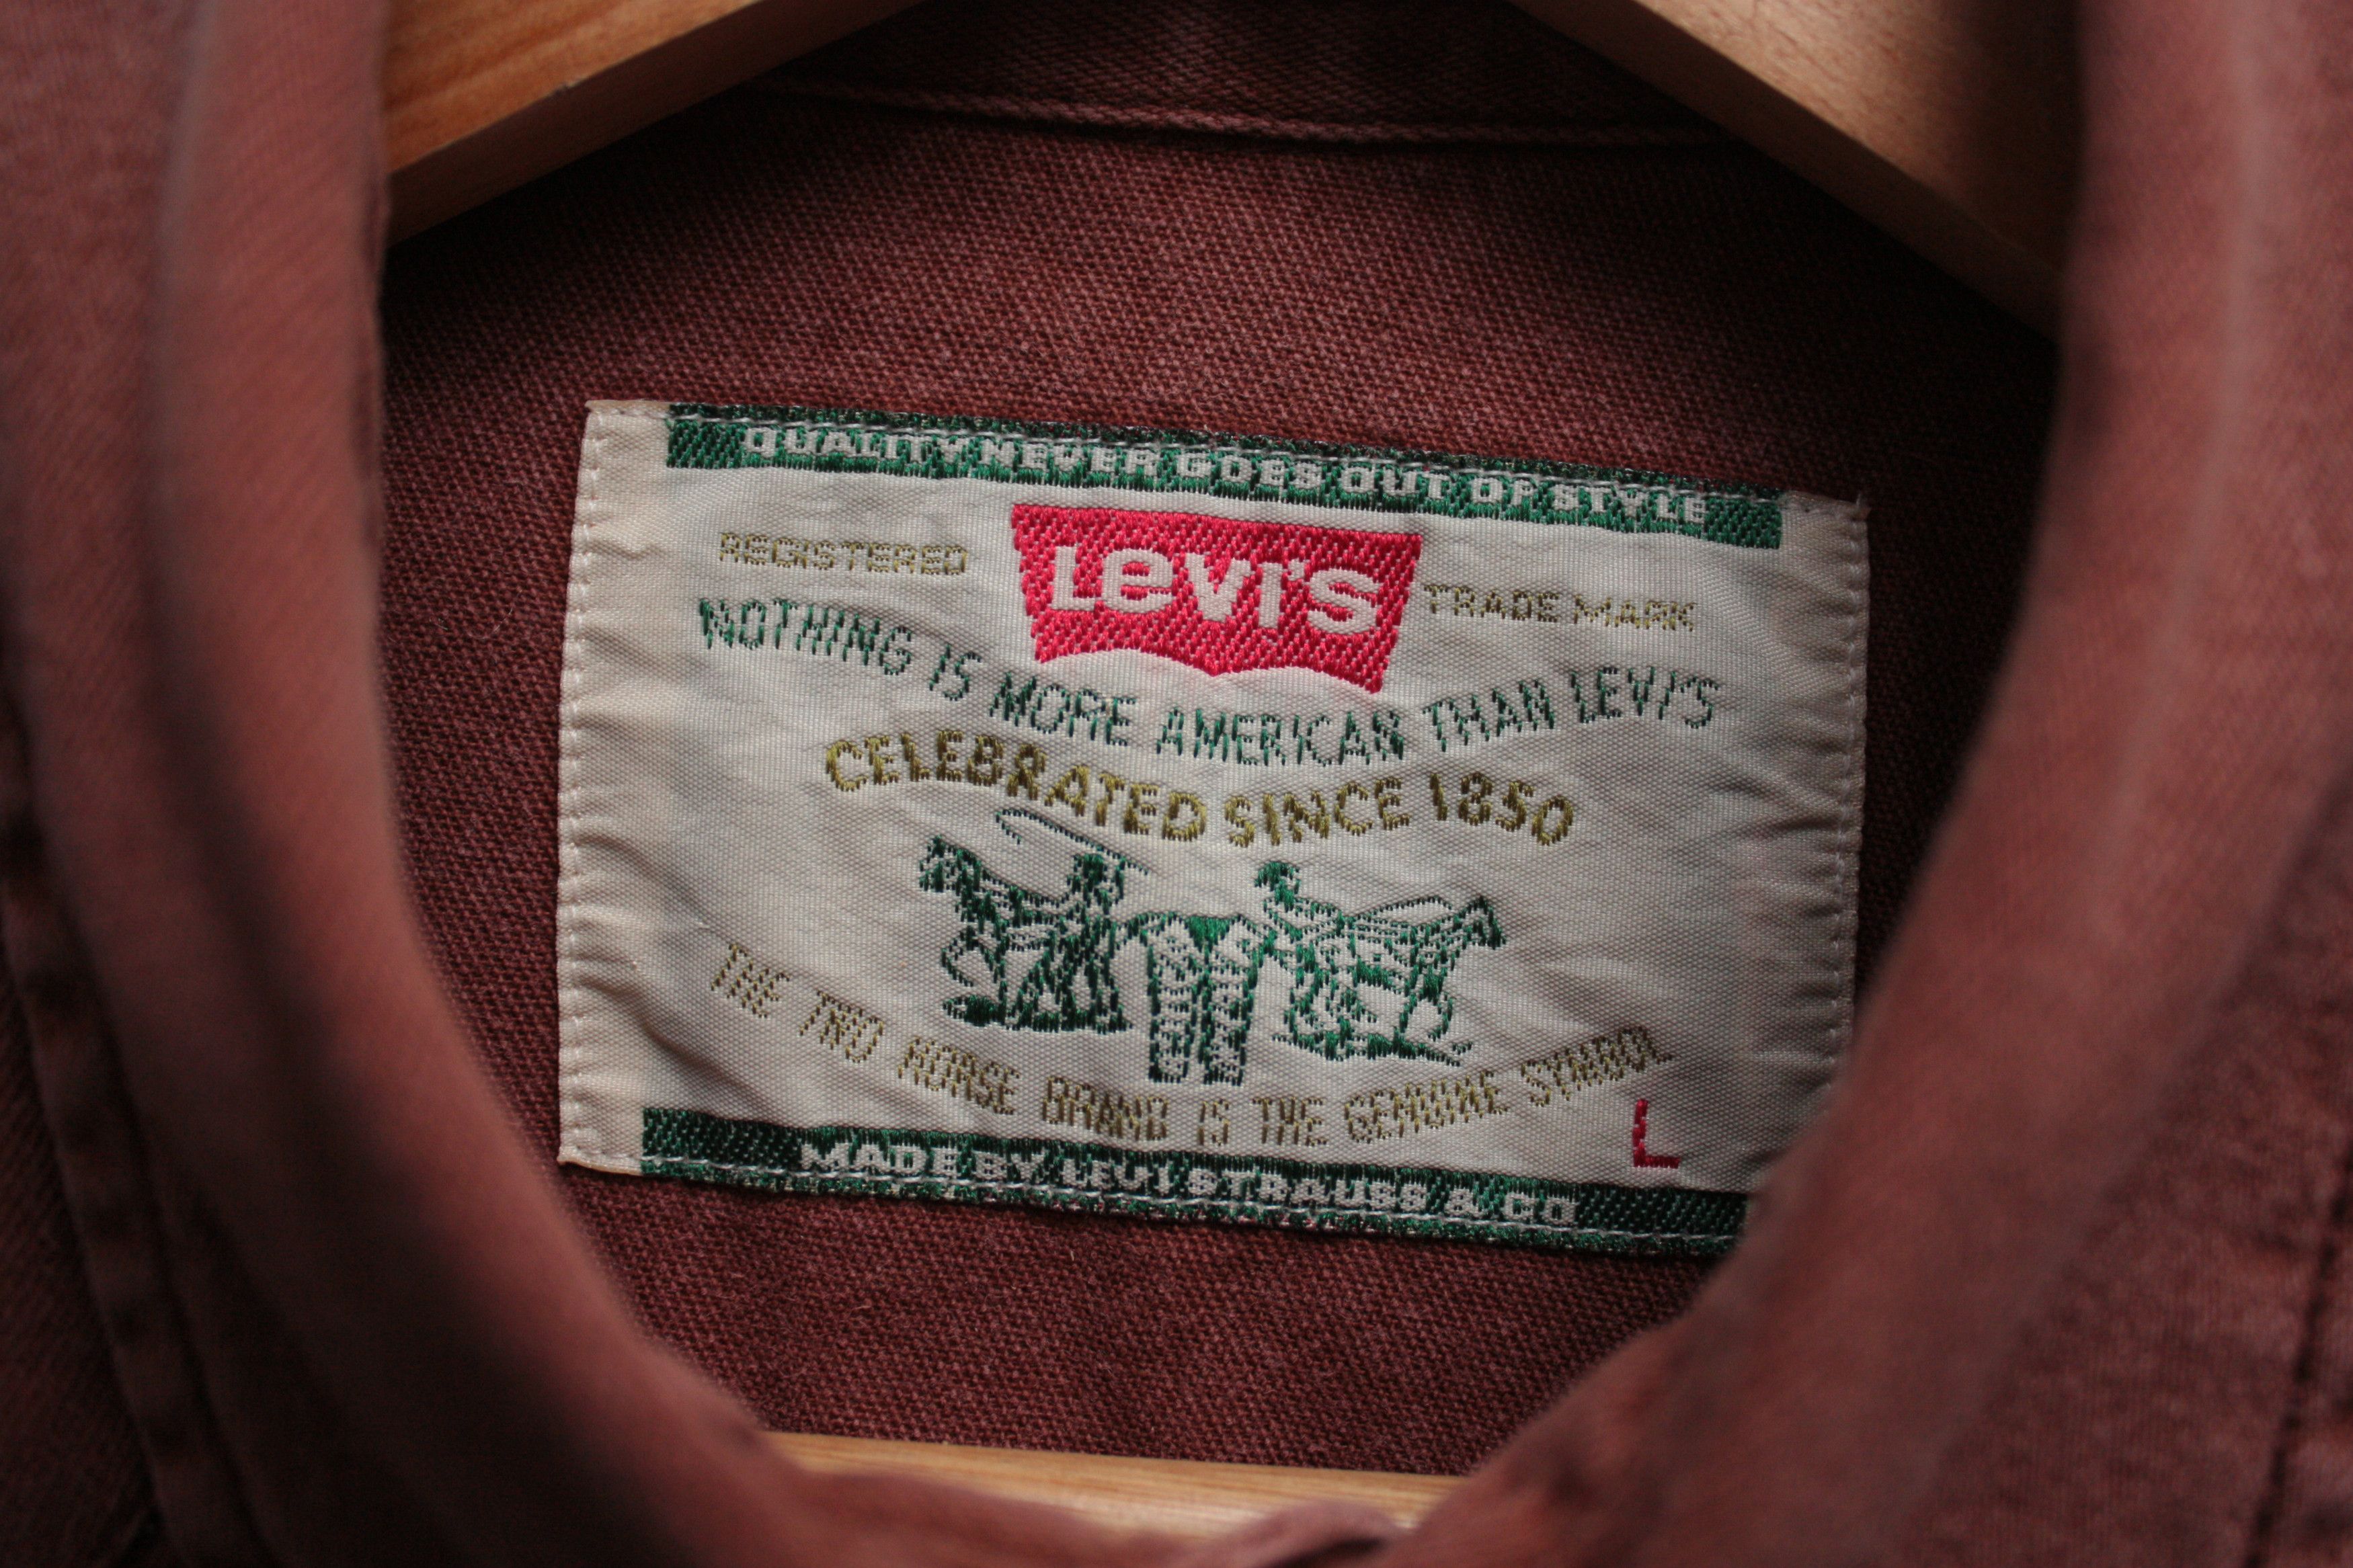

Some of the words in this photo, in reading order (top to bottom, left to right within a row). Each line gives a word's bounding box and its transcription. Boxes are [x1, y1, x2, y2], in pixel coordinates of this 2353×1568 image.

[743, 425, 969, 464] QUALITY
[980, 438, 1162, 477] NEVER
[1176, 449, 1323, 490] GOES
[1345, 464, 1452, 500] OUT
[1472, 477, 1540, 506] OF
[1552, 483, 1708, 524] STYLE
[720, 532, 969, 575] REGISTERED
[1051, 545, 1380, 635] Levi's
[1421, 582, 1562, 624] TRADE
[1572, 591, 1699, 632] MARK
[699, 597, 914, 675] NOTHING
[929, 643, 983, 701] IS
[989, 672, 1136, 746] MORE
[1156, 705, 1404, 768] AMERICAN
[1422, 678, 1555, 751] THAN
[1570, 665, 1719, 730] LEVI'S
[825, 730, 1207, 841] CELEBRATED
[1224, 776, 1411, 848] SINCE
[1429, 771, 1574, 847] 1850
[711, 943, 791, 1019] THE
[799, 989, 885, 1063] TWO
[898, 1036, 1020, 1116] HORSE
[1042, 1077, 1168, 1142] BRAND
[1197, 1098, 1230, 1146] IS
[1251, 1097, 1328, 1146] THE
[1345, 1071, 1509, 1143] GENUINE
[1521, 1026, 1675, 1107] SYMBOL
[1632, 1098, 1681, 1168] L
[801, 1142, 960, 1175] MADE
[971, 1149, 1045, 1180] BY
[1063, 1157, 1169, 1194] LEVI
[1188, 1167, 1427, 1212] STRAUSS
[1445, 1187, 1482, 1216] &
[1503, 1190, 1575, 1225] CO
